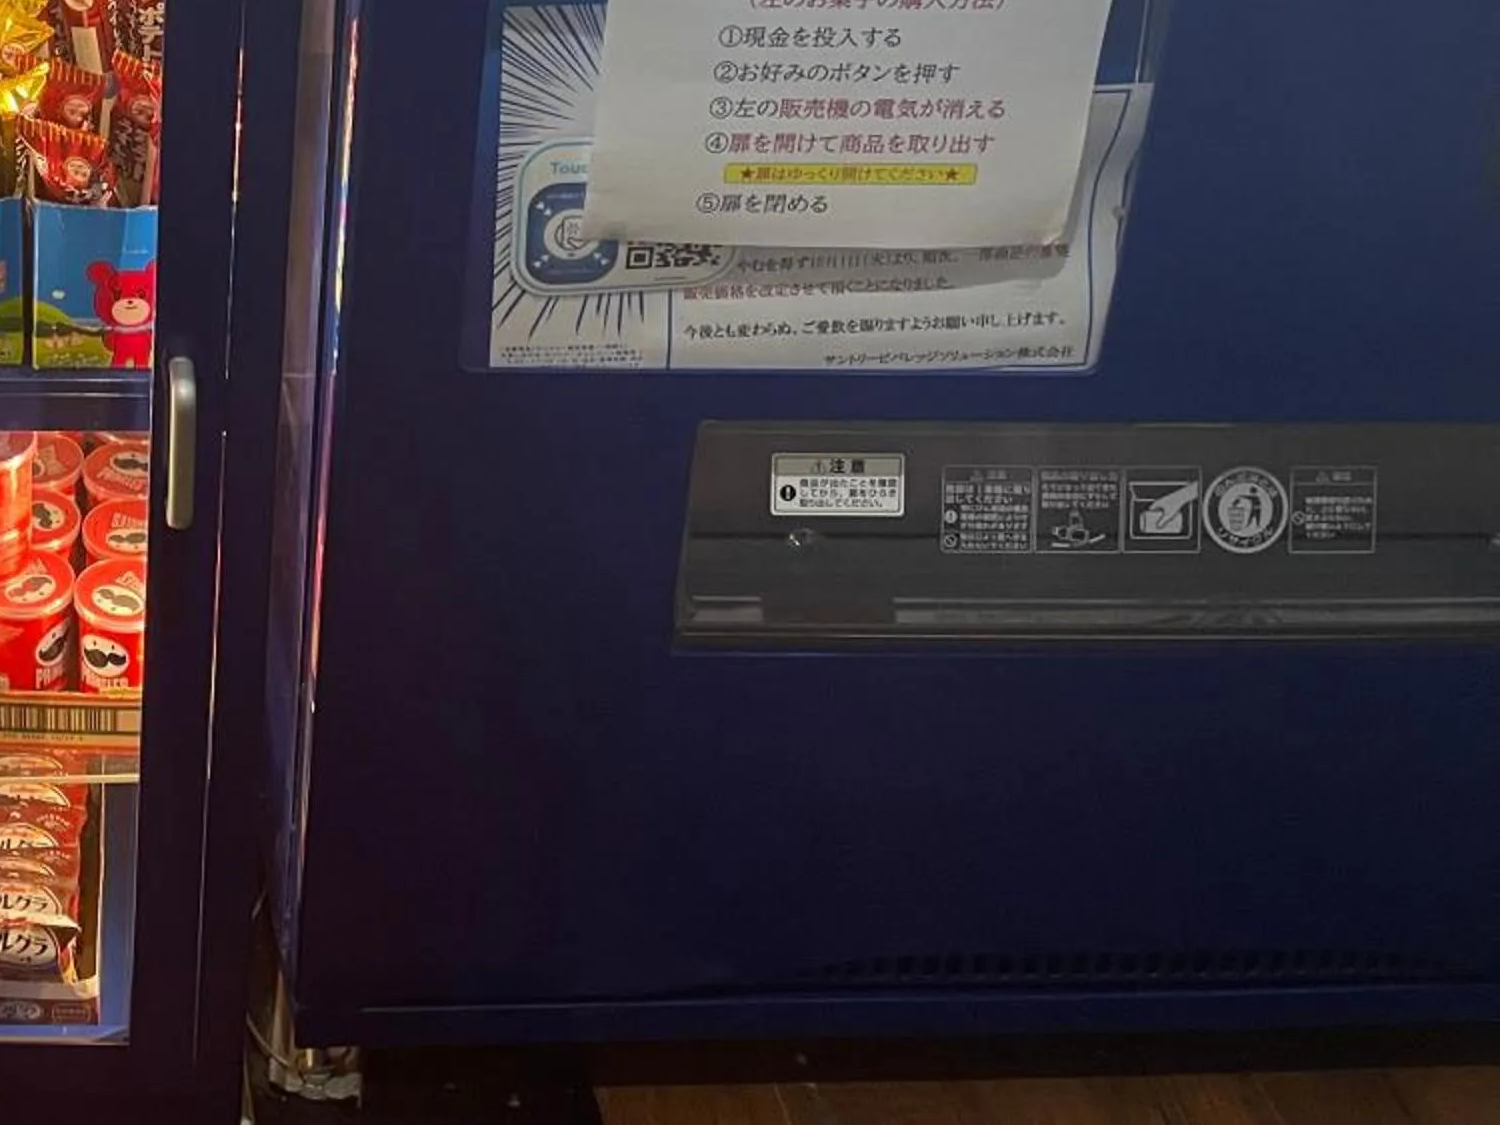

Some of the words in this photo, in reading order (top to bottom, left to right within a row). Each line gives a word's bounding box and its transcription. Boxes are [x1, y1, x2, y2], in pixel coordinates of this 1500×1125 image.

[718, 25, 902, 48] ①現金を投入する
[713, 60, 961, 84] ②お好みのボタンを押す
[709, 96, 1006, 119] ③左の販売機の電気が消える
[705, 131, 996, 154] ④扉を開けて商品を取り出す
[695, 192, 829, 213] ⑤扉を閉める
[829, 458, 866, 474] 注意
